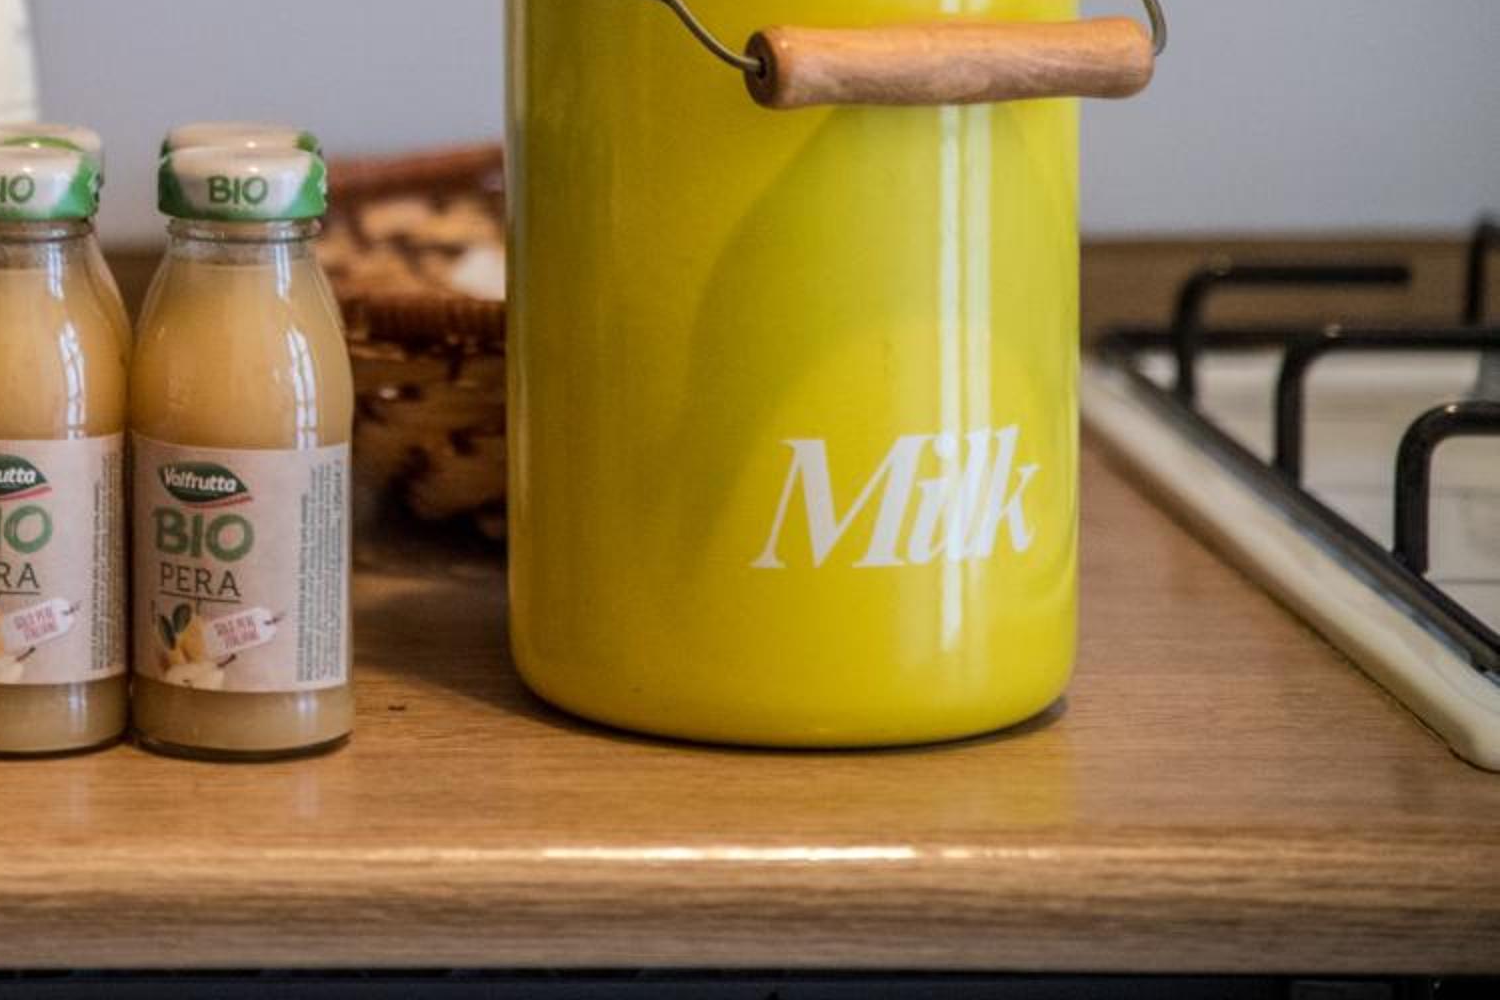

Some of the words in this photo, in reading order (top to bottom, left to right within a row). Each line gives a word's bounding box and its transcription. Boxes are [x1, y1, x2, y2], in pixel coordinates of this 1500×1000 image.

[206, 174, 268, 205] BIO
[162, 466, 237, 492] Valfrutta
[750, 424, 1042, 569] Milk
[152, 507, 255, 563] BIO
[160, 561, 242, 597] PERA
